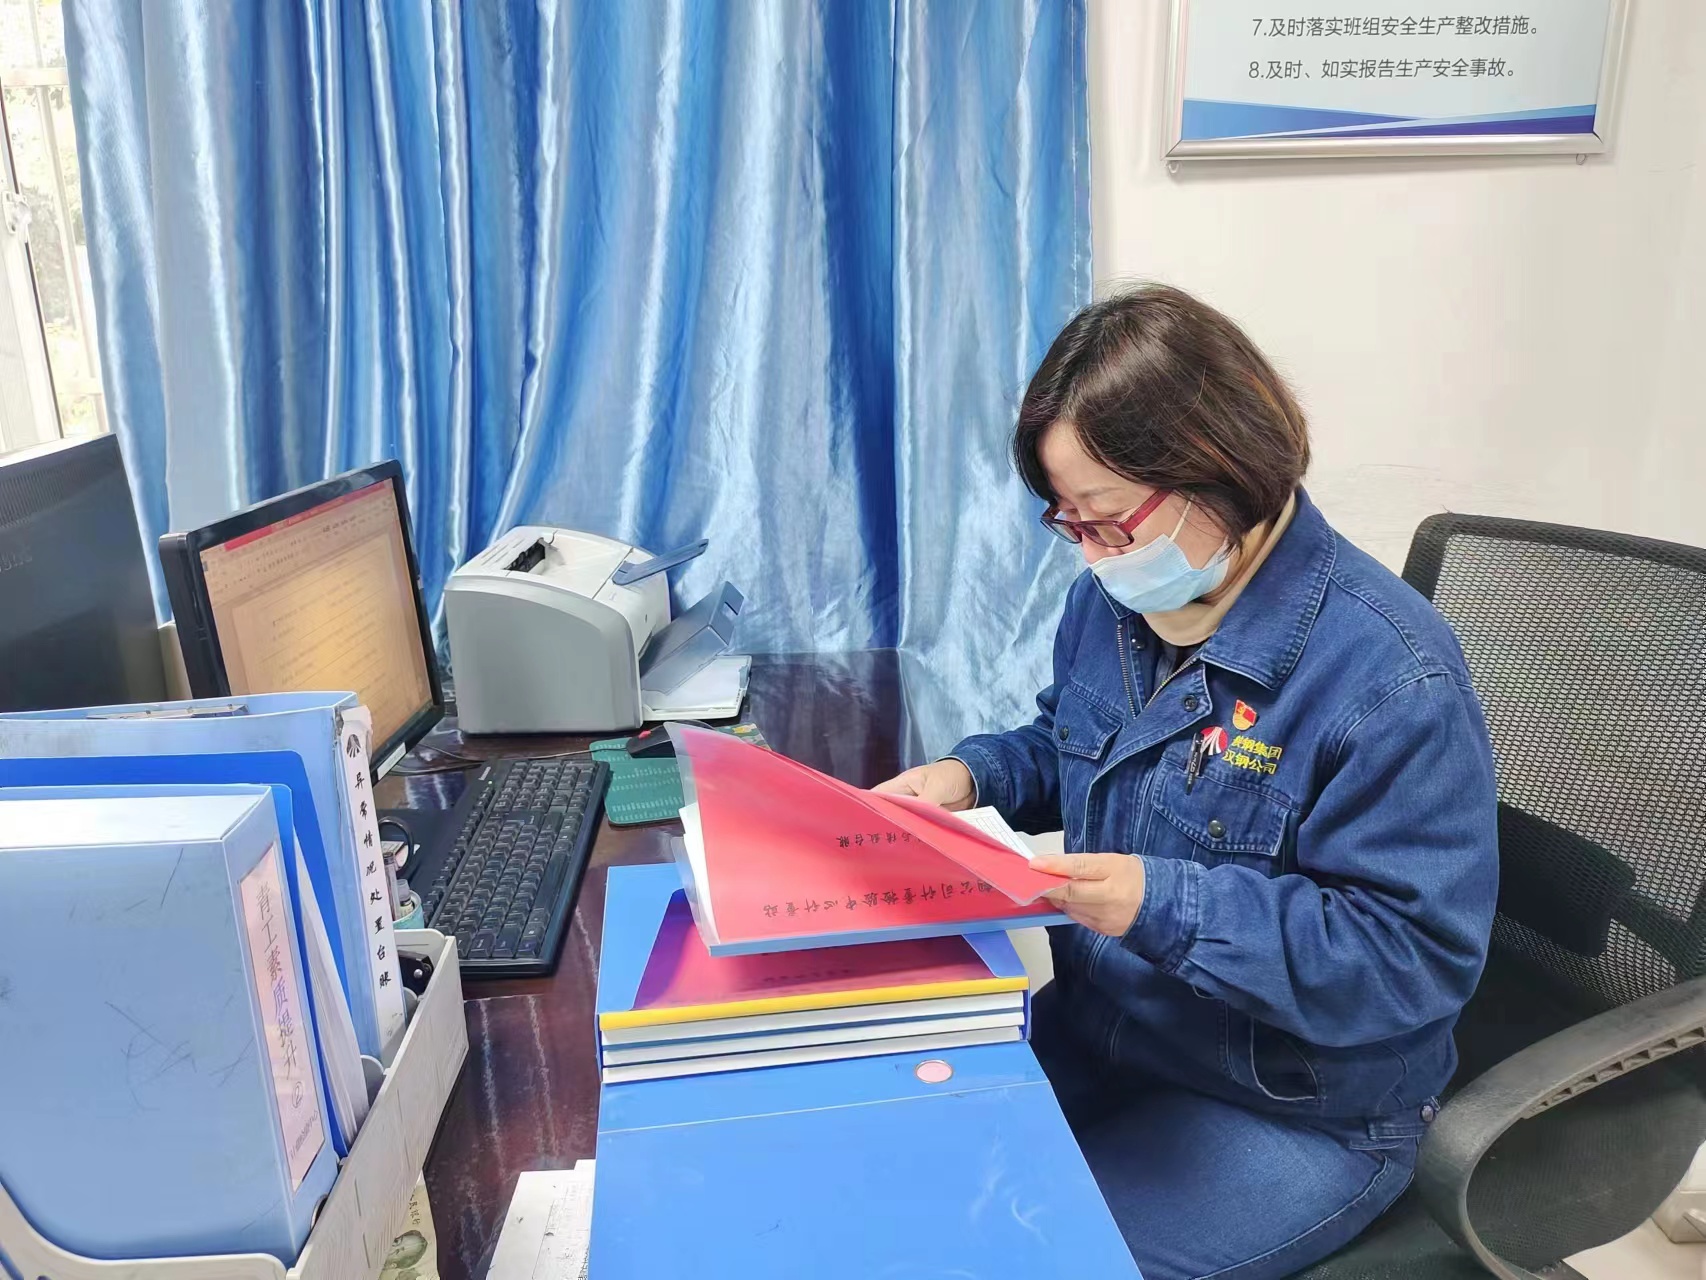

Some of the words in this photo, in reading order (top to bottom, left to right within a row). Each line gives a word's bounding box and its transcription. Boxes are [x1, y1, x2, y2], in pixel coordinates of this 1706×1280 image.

[1248, 57, 1516, 80] 8.及时、如实报告生产安全事故。
[1251, 15, 1540, 38] 7.及时落实班组安全生产整改措施。
[353, 771, 391, 990] 异常情况处置台账
[256, 881, 298, 1080] 青工素质提升
